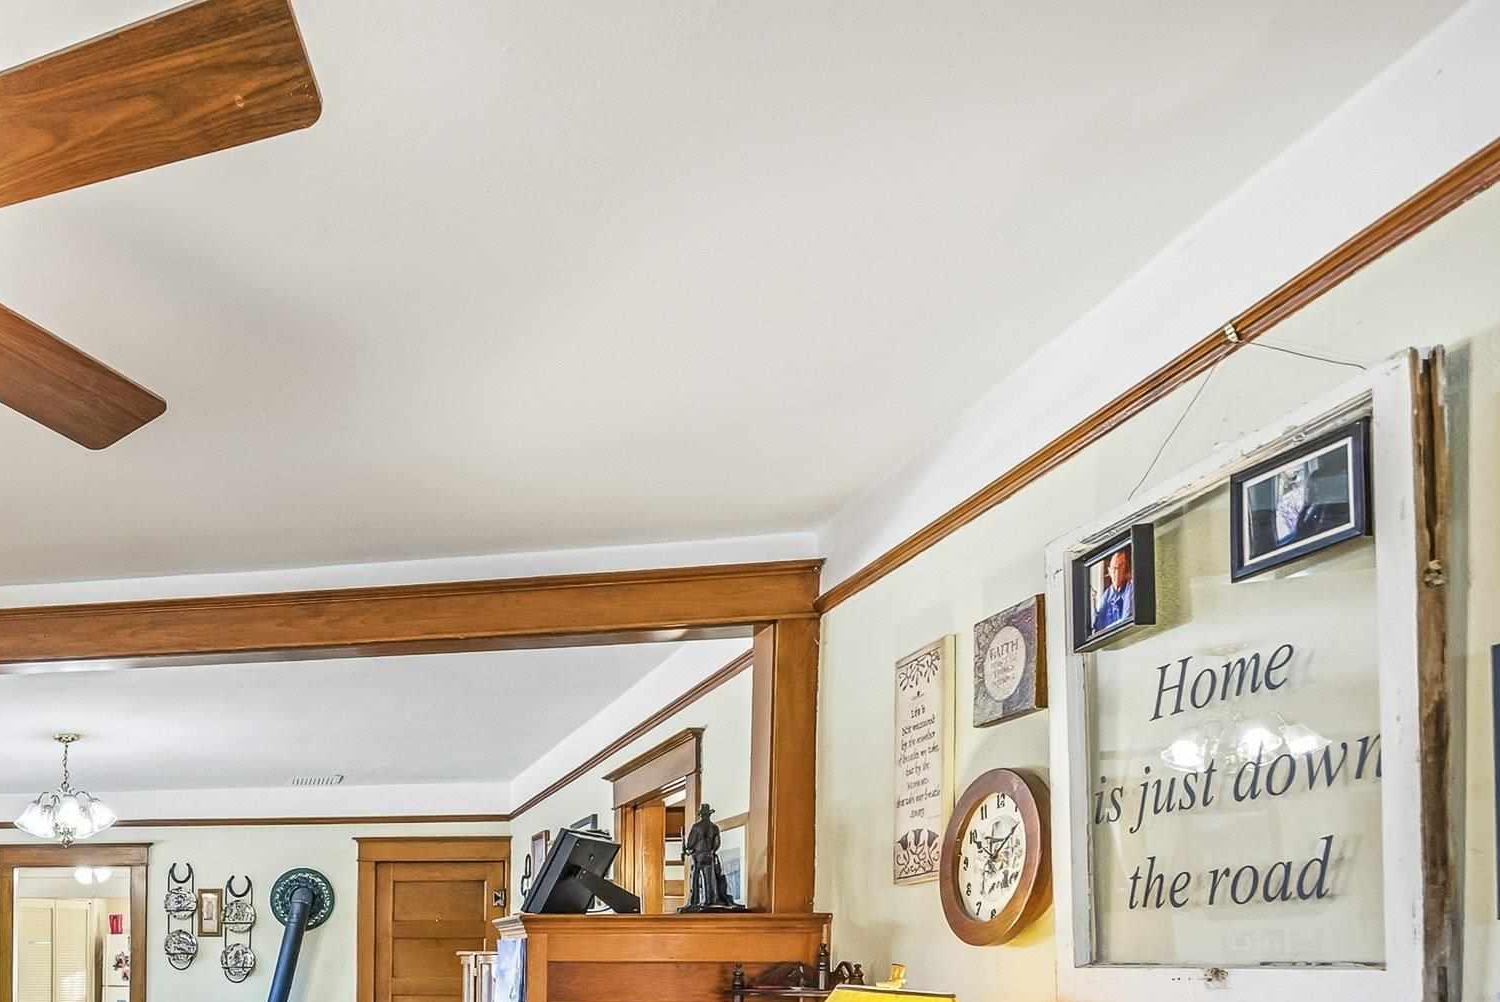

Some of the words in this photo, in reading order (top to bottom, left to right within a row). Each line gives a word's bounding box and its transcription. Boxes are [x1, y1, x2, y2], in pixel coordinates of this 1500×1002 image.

[1149, 643, 1294, 722] Home
[1093, 775, 1124, 825] is
[1129, 758, 1218, 834] just
[1233, 733, 1382, 803] down
[1128, 855, 1192, 910] the
[1208, 834, 1334, 906] road
